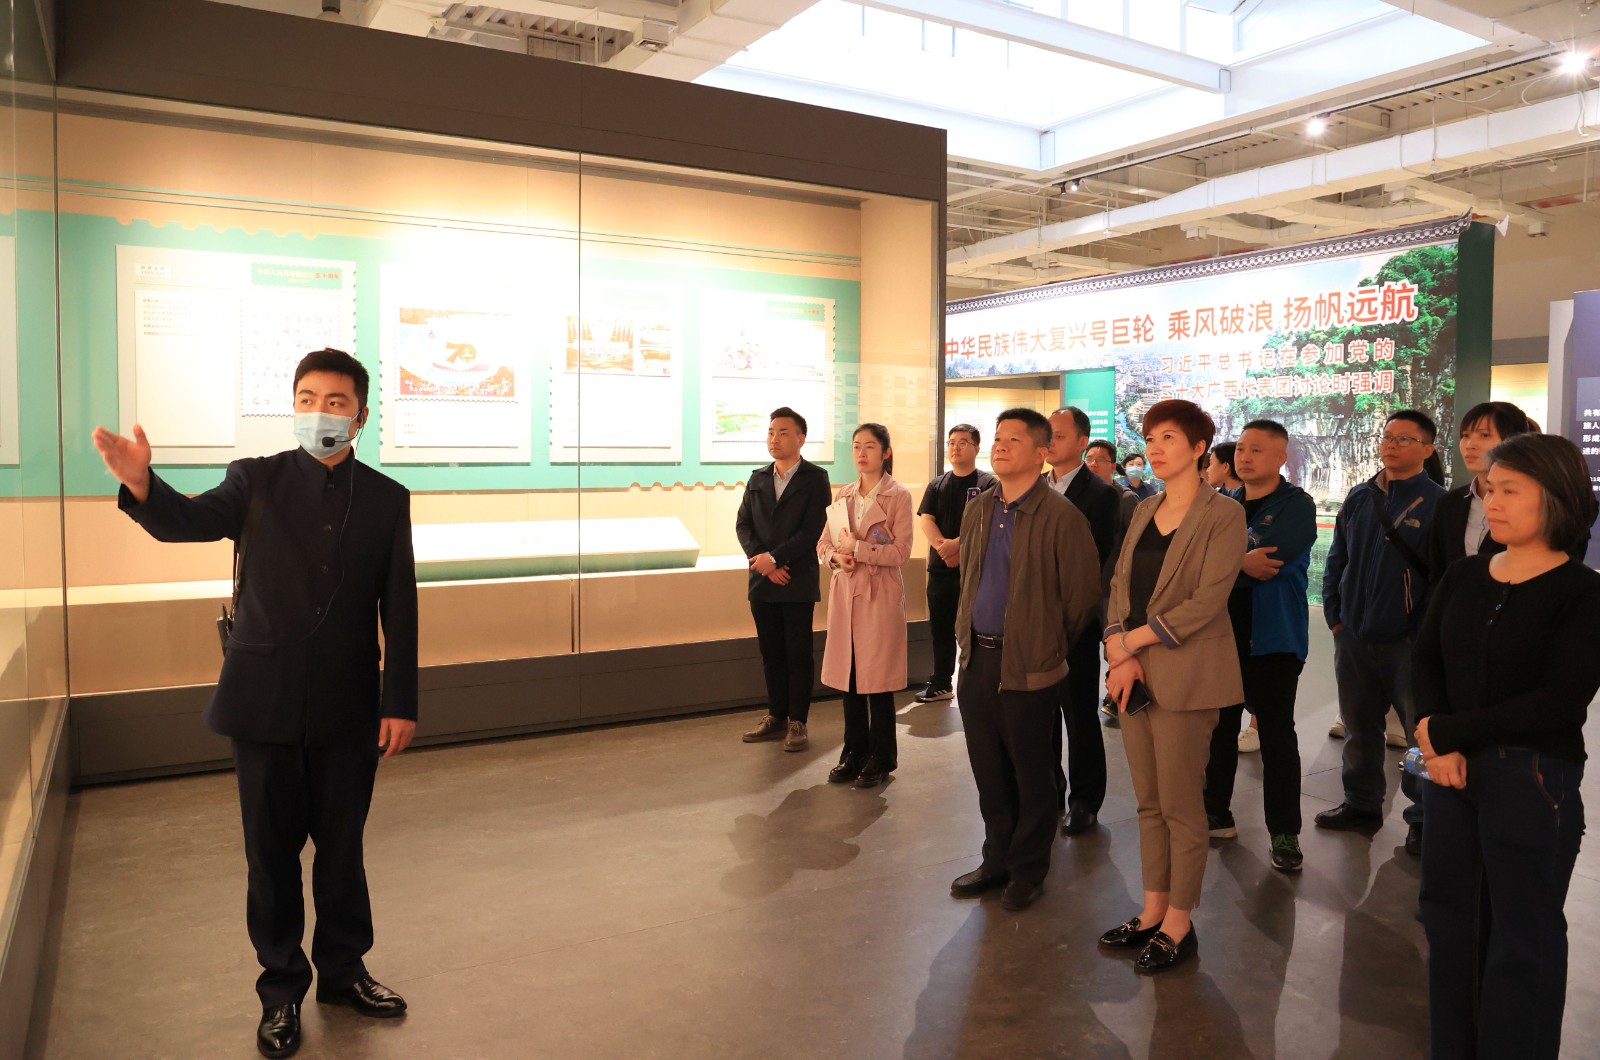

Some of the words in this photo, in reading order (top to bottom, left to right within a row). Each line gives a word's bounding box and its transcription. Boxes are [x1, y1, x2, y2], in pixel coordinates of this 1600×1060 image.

[945, 314, 1155, 361] 中华民族伟大复兴号巨轮
[1167, 300, 1273, 341] 乘风破浪
[1284, 282, 1417, 330] 扬帆远航
[1160, 339, 1396, 374] 习近平总书记在参加党的
[1160, 371, 1394, 401] 二十大广西代表团讨论时强调
